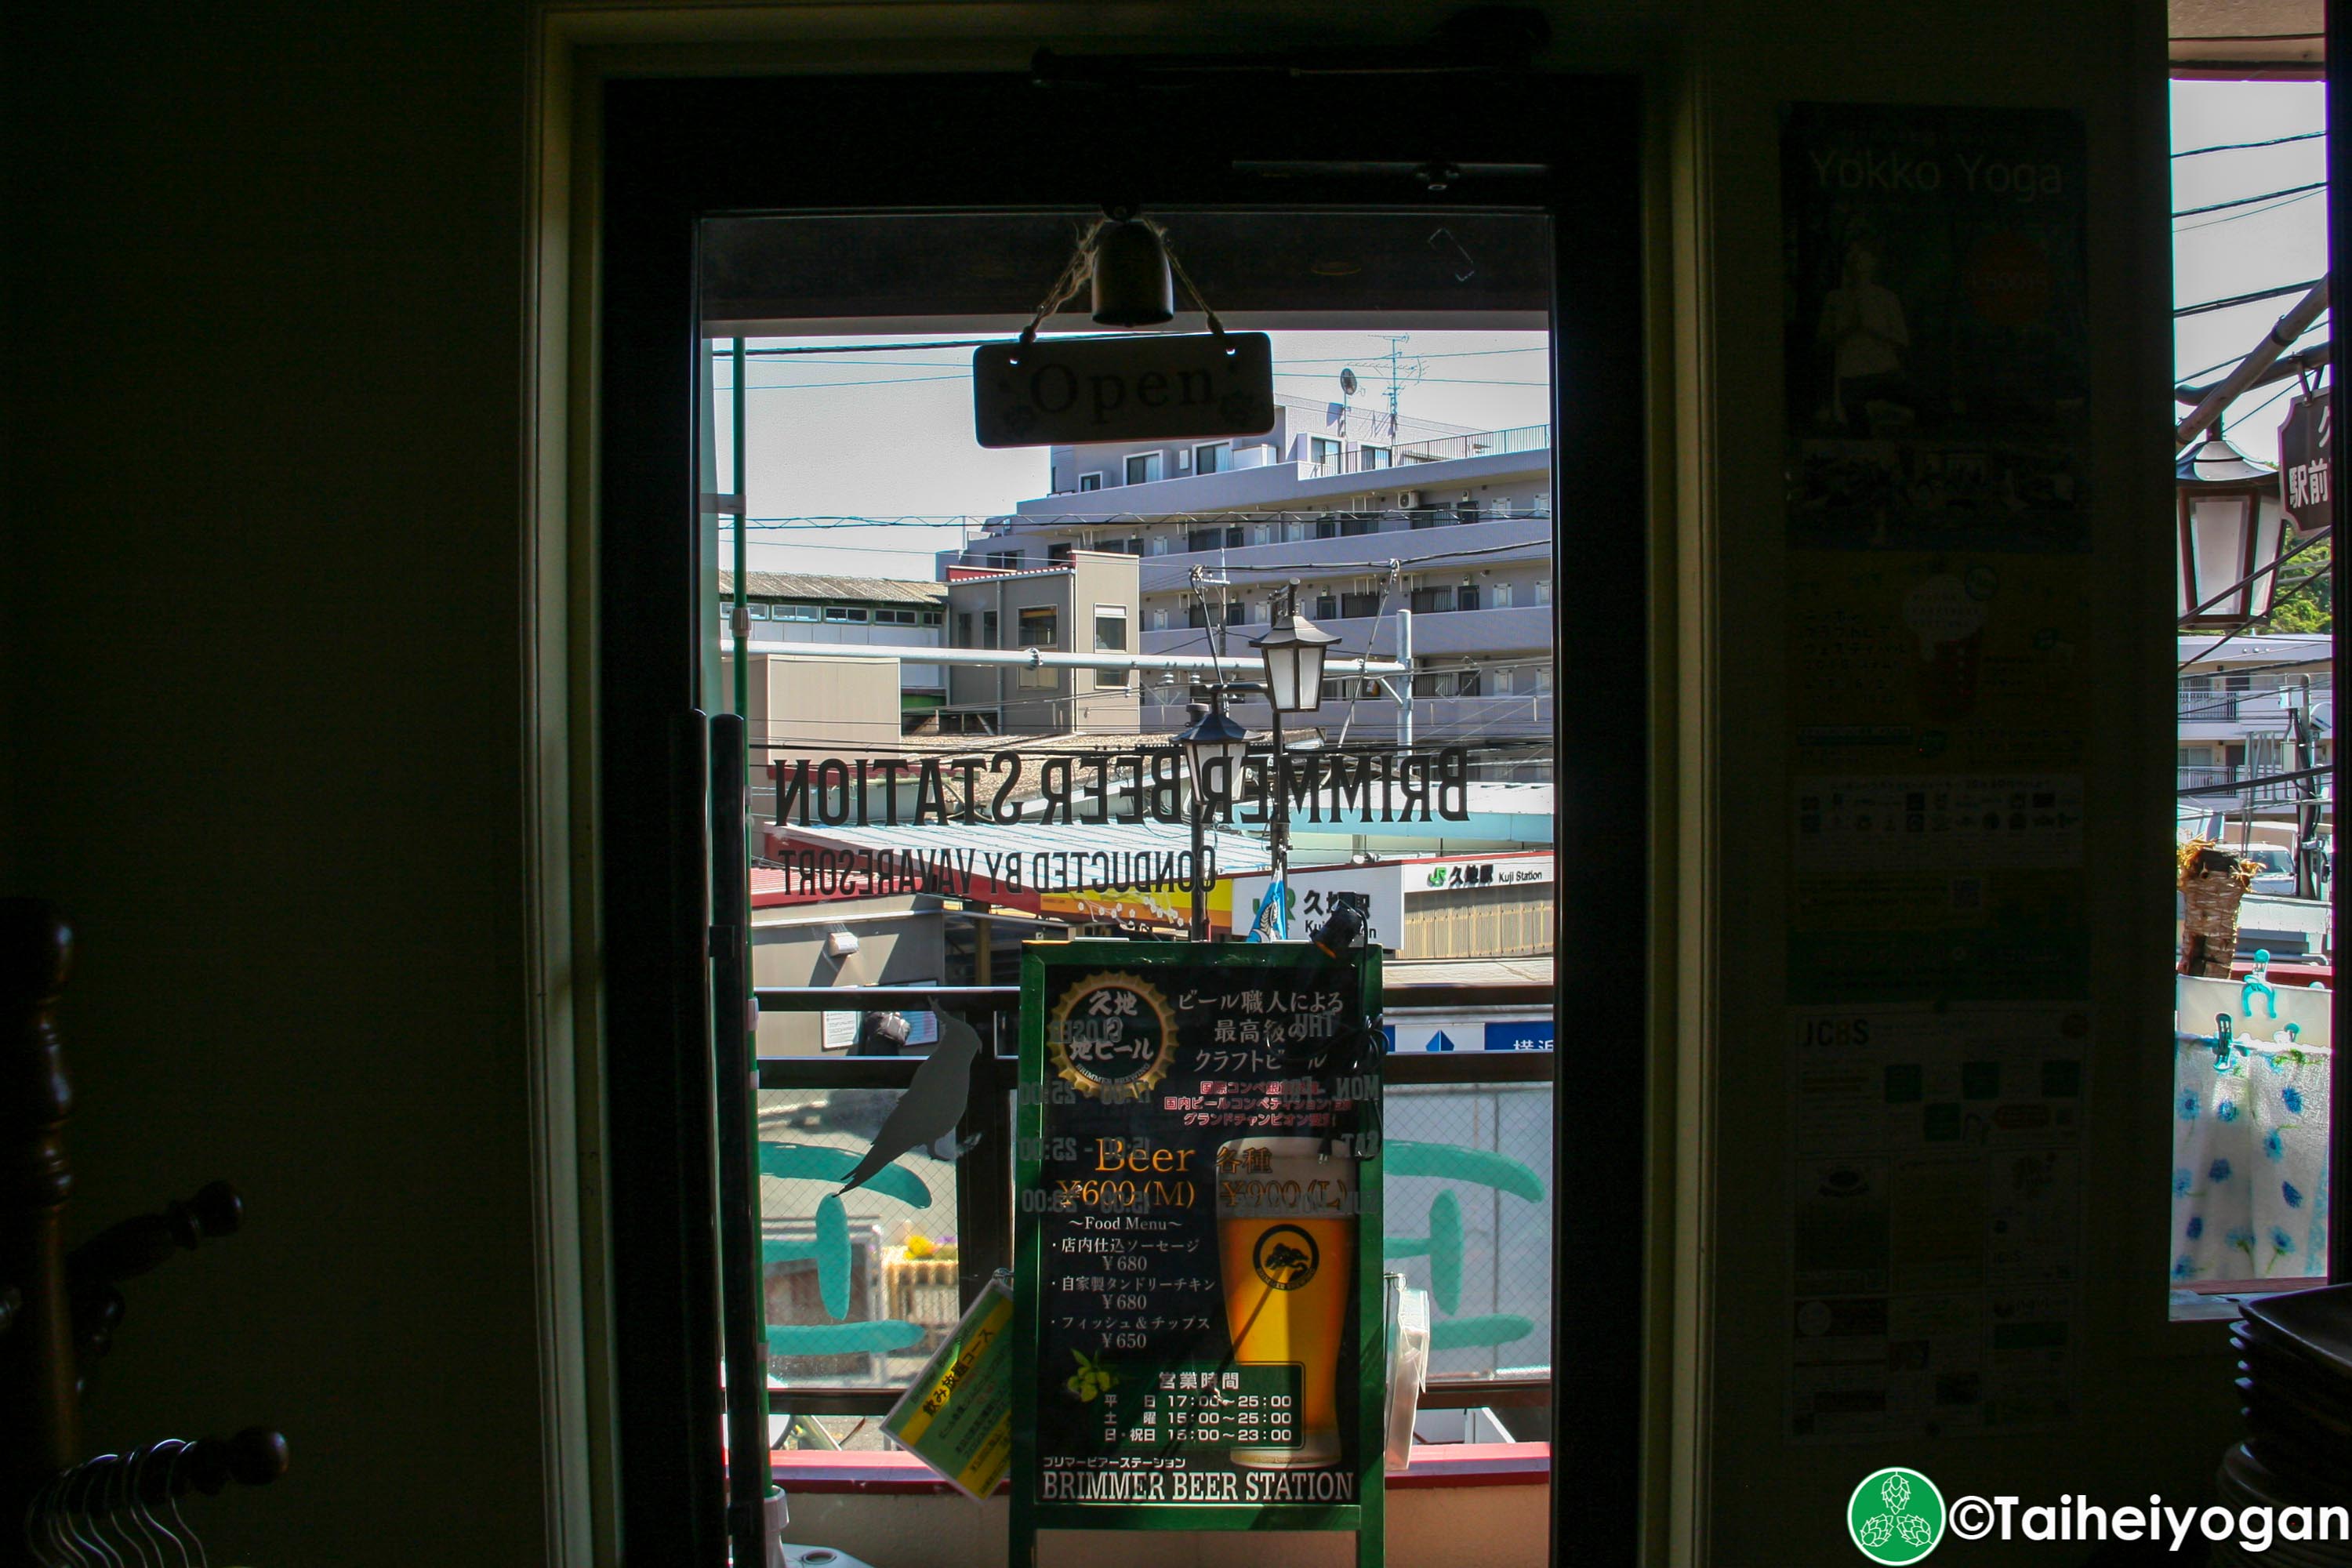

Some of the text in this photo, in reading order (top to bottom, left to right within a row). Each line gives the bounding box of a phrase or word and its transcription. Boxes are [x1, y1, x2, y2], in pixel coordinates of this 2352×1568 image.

[1808, 149, 2063, 203] Yokko Yoga
[1031, 363, 1218, 425] Open
[1498, 869, 1543, 885] Kuji Station
[1178, 989, 1344, 1014] ビール職人による
[1193, 1048, 1327, 1073] クラフトビル
[1094, 1138, 1196, 1172] Beer
[1215, 1146, 1273, 1174] 各種
[1102, 1333, 1148, 1348] ¥650
[1158, 1372, 1240, 1390] 営業時間
[1042, 1471, 1165, 1500] BRIMMER
[1172, 1471, 1238, 1500] BEER
[1245, 1471, 1354, 1500] STATION
